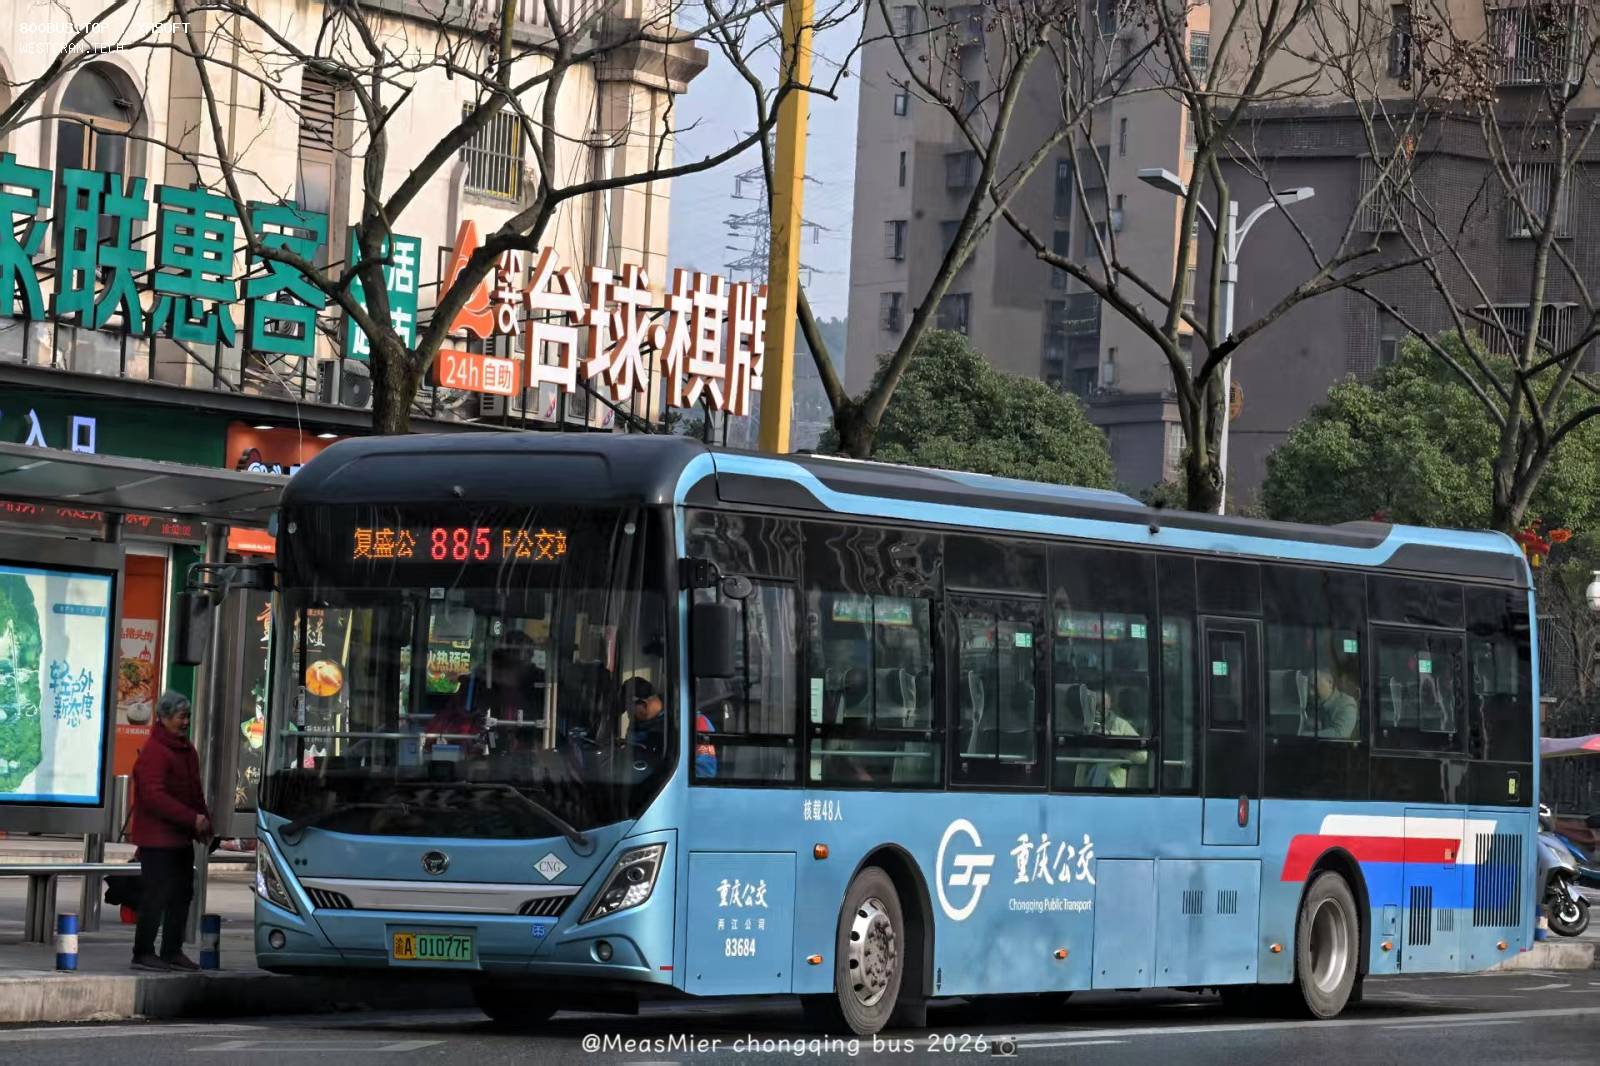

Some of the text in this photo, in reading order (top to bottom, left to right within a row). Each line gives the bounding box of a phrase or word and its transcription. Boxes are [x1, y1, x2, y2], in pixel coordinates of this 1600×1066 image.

[445, 356, 512, 390] 24h 自助
[25, 408, 96, 454] 入口
[430, 528, 492, 560] 885
[803, 800, 844, 821] 核载48人
[539, 861, 561, 873] CNG
[1010, 833, 1096, 885] 重庆公交
[716, 879, 769, 908] 重庆公交
[1008, 898, 1093, 914] Chongqing Public Transport
[724, 938, 757, 957] 83684
